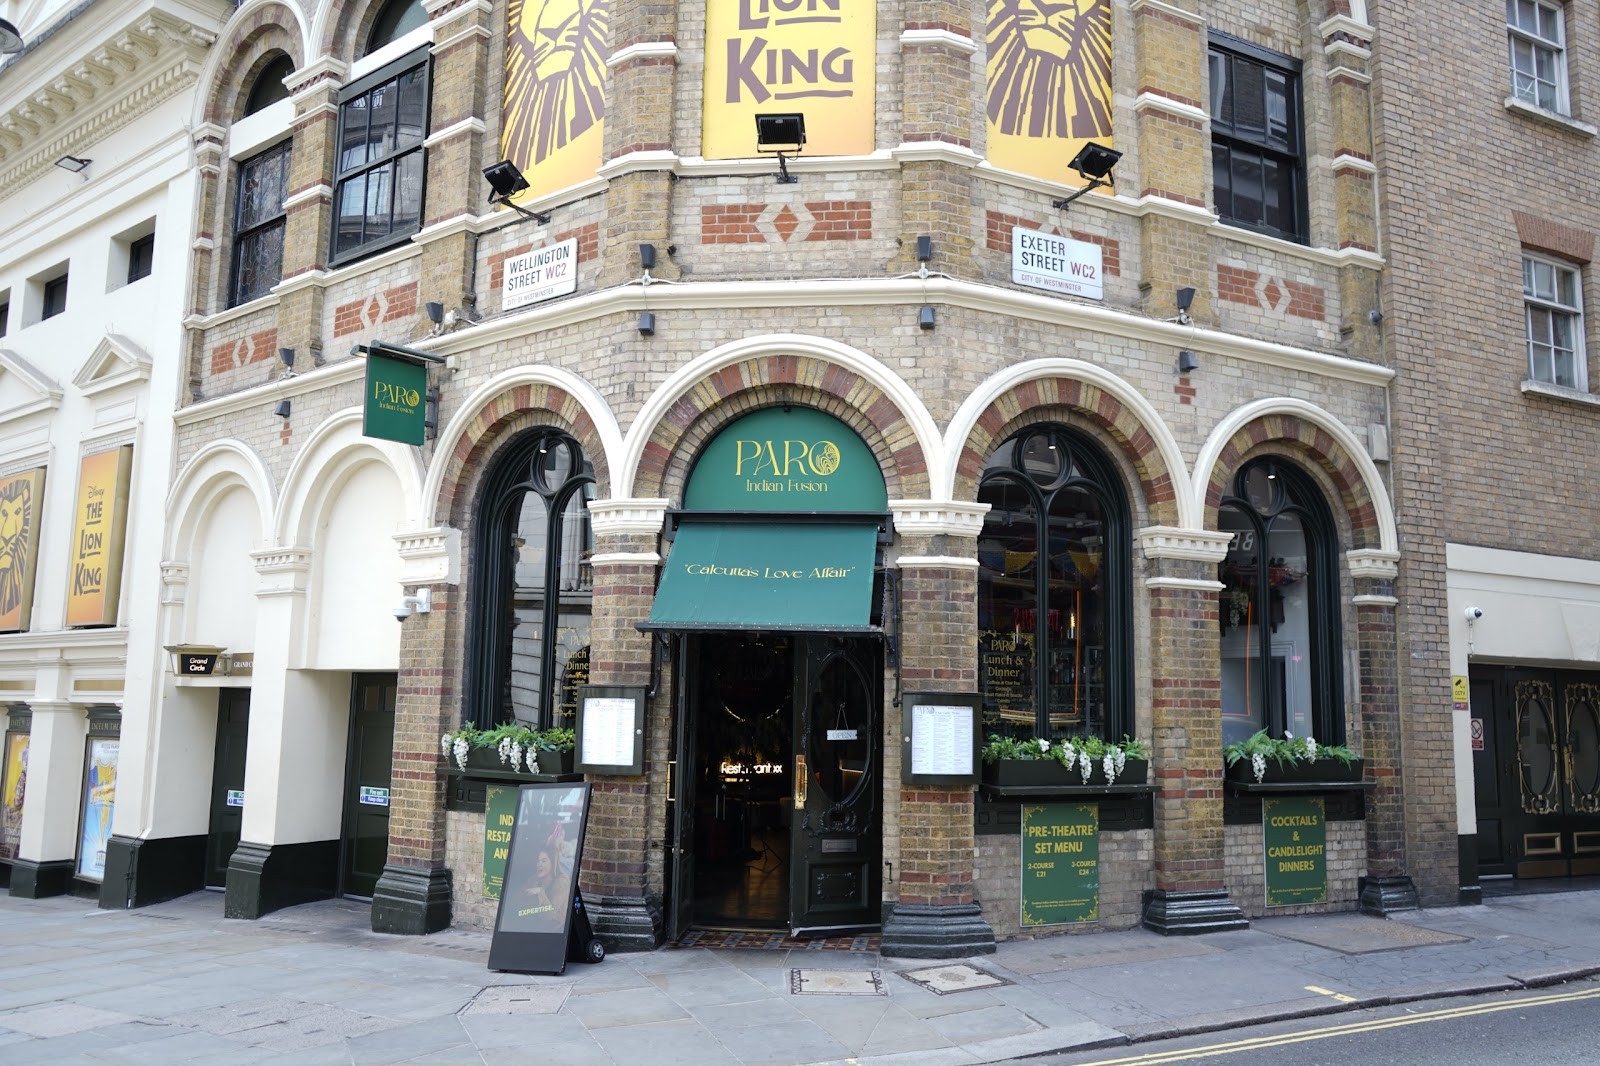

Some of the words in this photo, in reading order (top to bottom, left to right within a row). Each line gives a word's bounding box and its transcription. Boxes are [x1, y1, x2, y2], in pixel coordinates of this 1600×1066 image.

[726, 36, 853, 104] KING
[1021, 234, 1065, 256] EXETER
[510, 245, 570, 274] WELLINGTON
[1021, 251, 1065, 272] STREET
[1070, 261, 1095, 280] WC2
[509, 270, 541, 291] STREET
[546, 263, 566, 280] WC2
[1044, 278, 1081, 292] WESTMINSTER
[375, 381, 420, 407] PARO
[735, 440, 841, 476] PARO
[87, 485, 105, 499] Disney
[746, 479, 783, 492] Indian
[788, 479, 828, 492] Fusion
[86, 501, 103, 520] THE
[79, 529, 102, 559] LION
[74, 562, 101, 596] KING
[764, 567, 803, 579] Love
[991, 639, 1016, 652] PARO
[563, 649, 587, 659] Lunch
[983, 654, 1012, 665] Lunch
[1015, 656, 1024, 666] &
[566, 661, 589, 671] Dinne
[988, 666, 1020, 677] Dinner
[1271, 815, 1318, 827] COCKTAILS
[1028, 825, 1093, 837] PRE-THEATRE
[1292, 830, 1300, 842] &
[493, 847, 508, 860] AN
[1034, 842, 1053, 854] SET
[1054, 841, 1083, 853] MENU
[1268, 845, 1323, 858] CANDLELIGHT
[1027, 862, 1054, 870] 2-COURSE
[1071, 860, 1097, 868] 3-COURSE
[1279, 860, 1315, 873] DINNERS
[517, 904, 554, 917] EXPERTISE.
